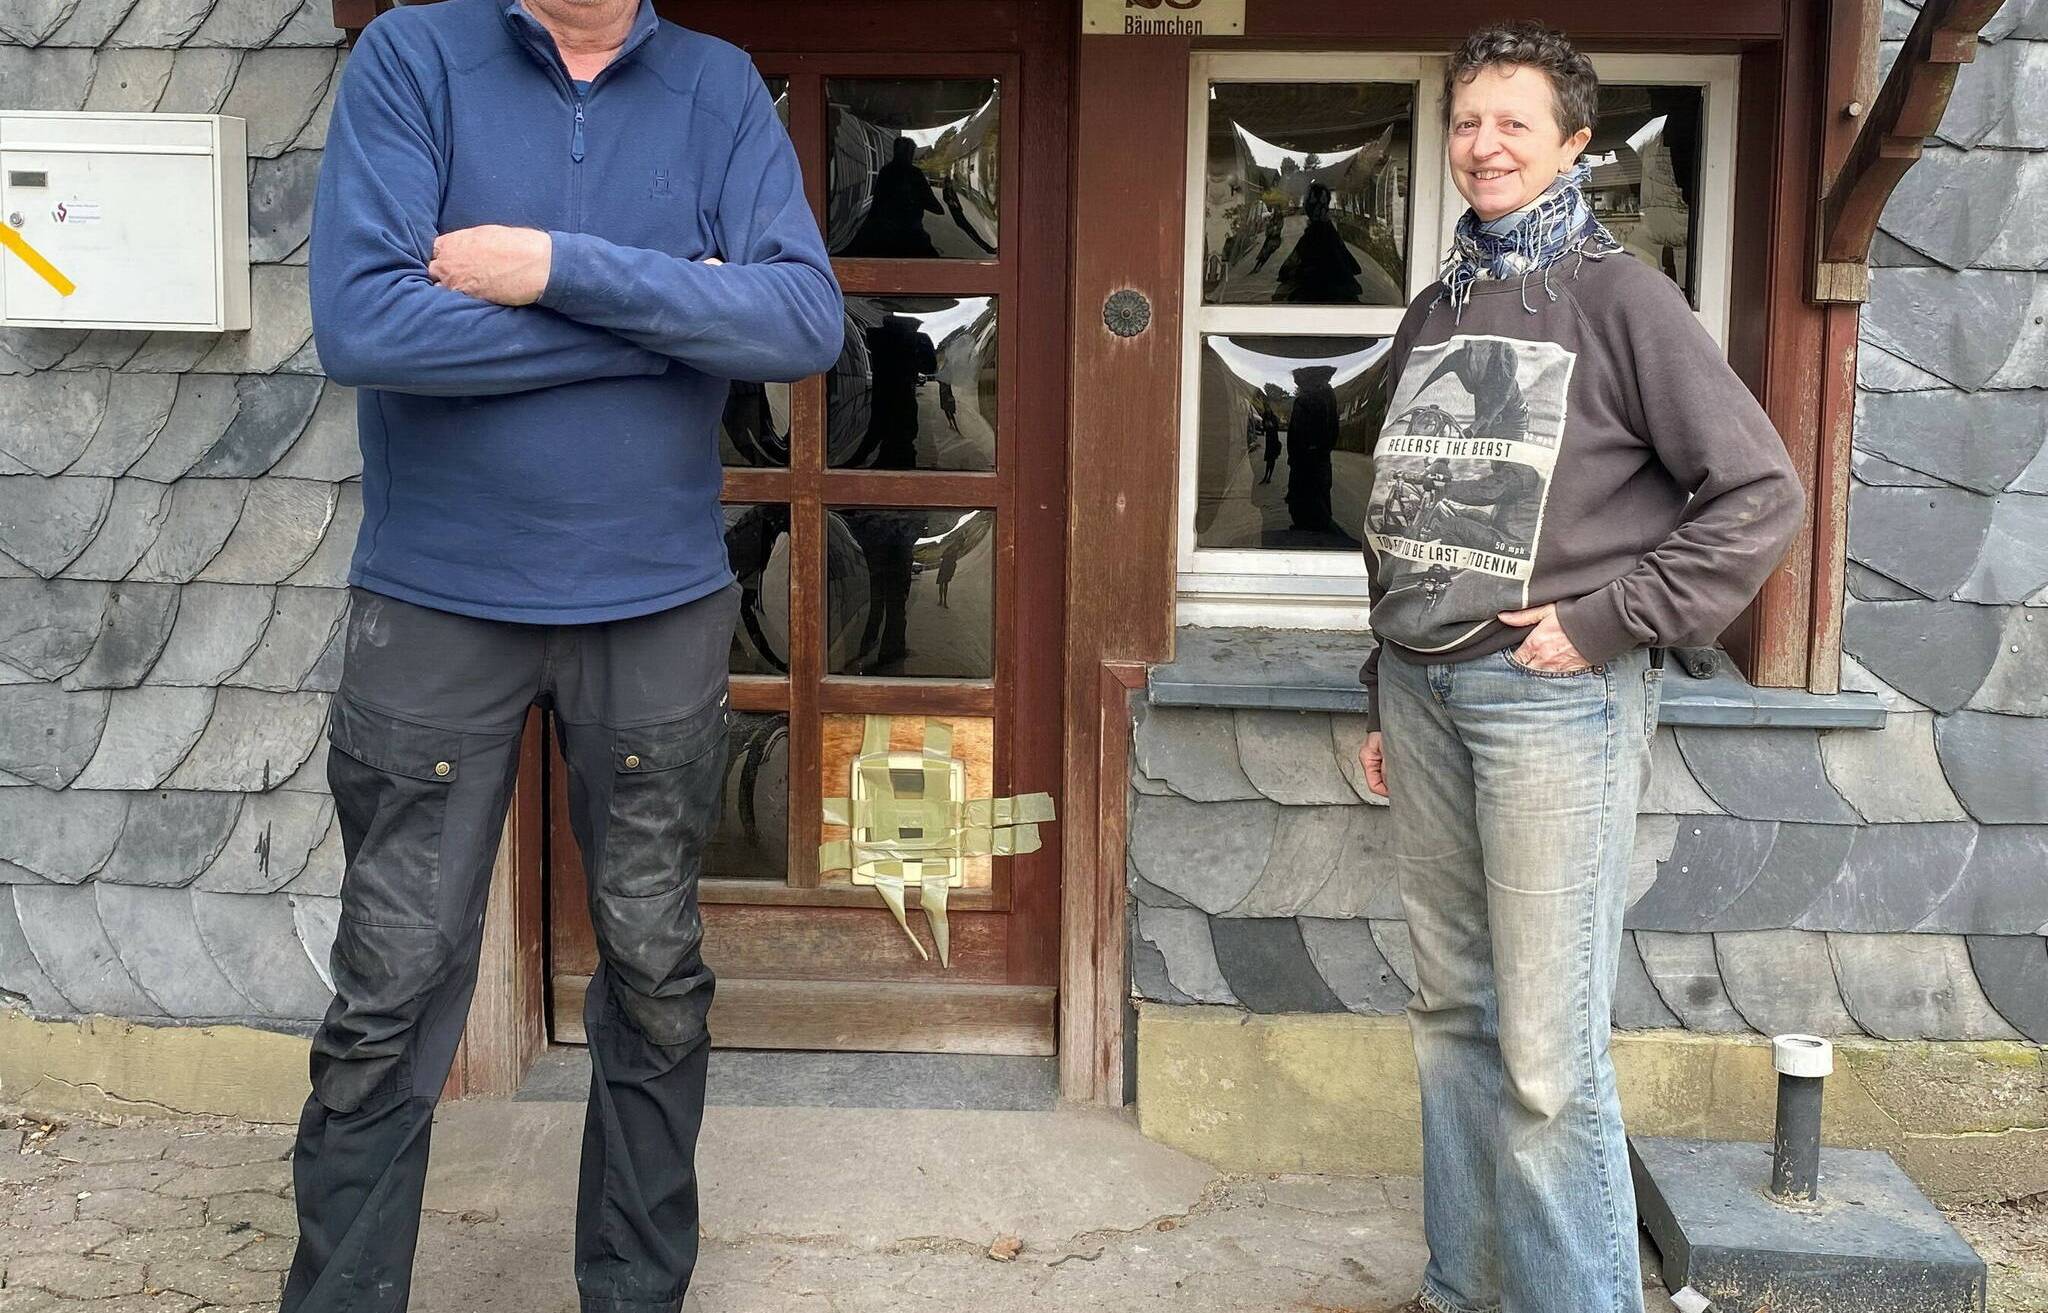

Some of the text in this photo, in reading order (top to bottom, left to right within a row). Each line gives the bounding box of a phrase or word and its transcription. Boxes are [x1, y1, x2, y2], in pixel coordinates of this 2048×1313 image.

[1124, 15, 1203, 35] Bäumchen
[1388, 438, 1512, 458] RELEASE THE BEAST
[1412, 543, 1425, 559] BE
[1429, 546, 1459, 563] LAST
[1495, 541, 1506, 551] 50
